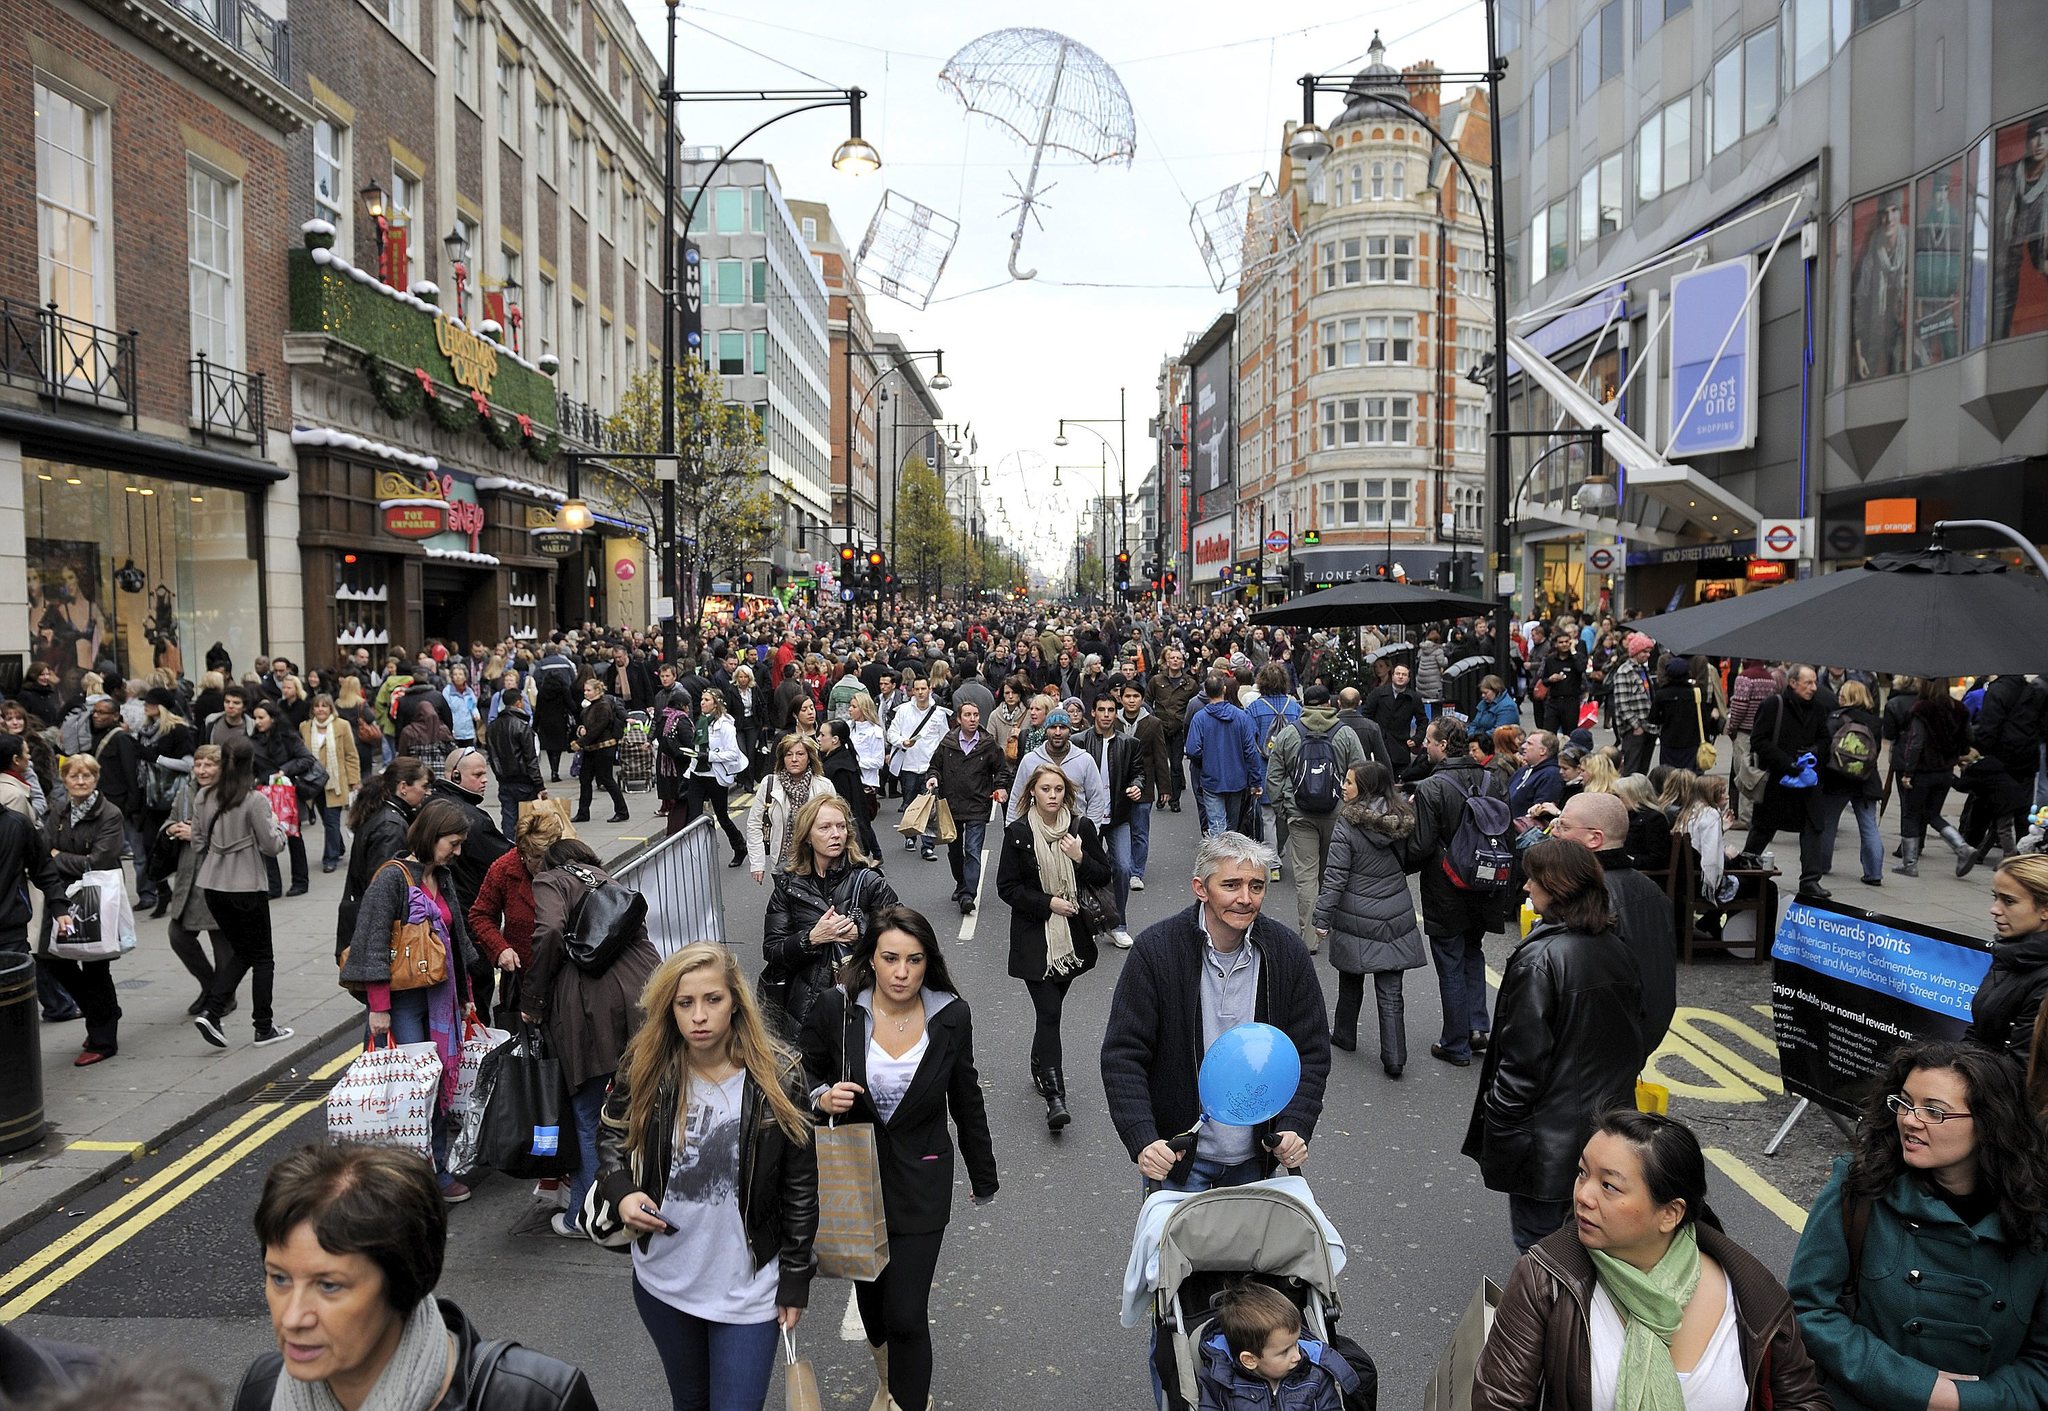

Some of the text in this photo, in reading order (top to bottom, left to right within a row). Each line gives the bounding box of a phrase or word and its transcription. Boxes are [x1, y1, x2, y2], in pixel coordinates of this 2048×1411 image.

[686, 265, 700, 313] HMV
[1706, 396, 1736, 416] one
[1696, 421, 1735, 435] SHOPPING
[390, 520, 436, 529] EMPORIUM
[403, 511, 423, 520] TOY
[1884, 523, 1914, 533] orange
[541, 544, 570, 552] MARLEY
[1680, 547, 1703, 561] STREET
[1704, 544, 1733, 559] STATION
[1785, 908, 1912, 955] ouble rewards points
[1778, 929, 1786, 938] or
[1797, 933, 1831, 951] American
[1867, 953, 1928, 981] Cardmembers
[1930, 973, 1957, 989] when
[1775, 939, 1972, 1011] Regent Street and Marylebone High Street on 5 a
[1797, 988, 1820, 1006] double
[1820, 1000, 1836, 1013] your
[1836, 1007, 1865, 1024] normal
[1865, 1017, 1898, 1036] rewards
[1898, 1029, 1913, 1041] on:
